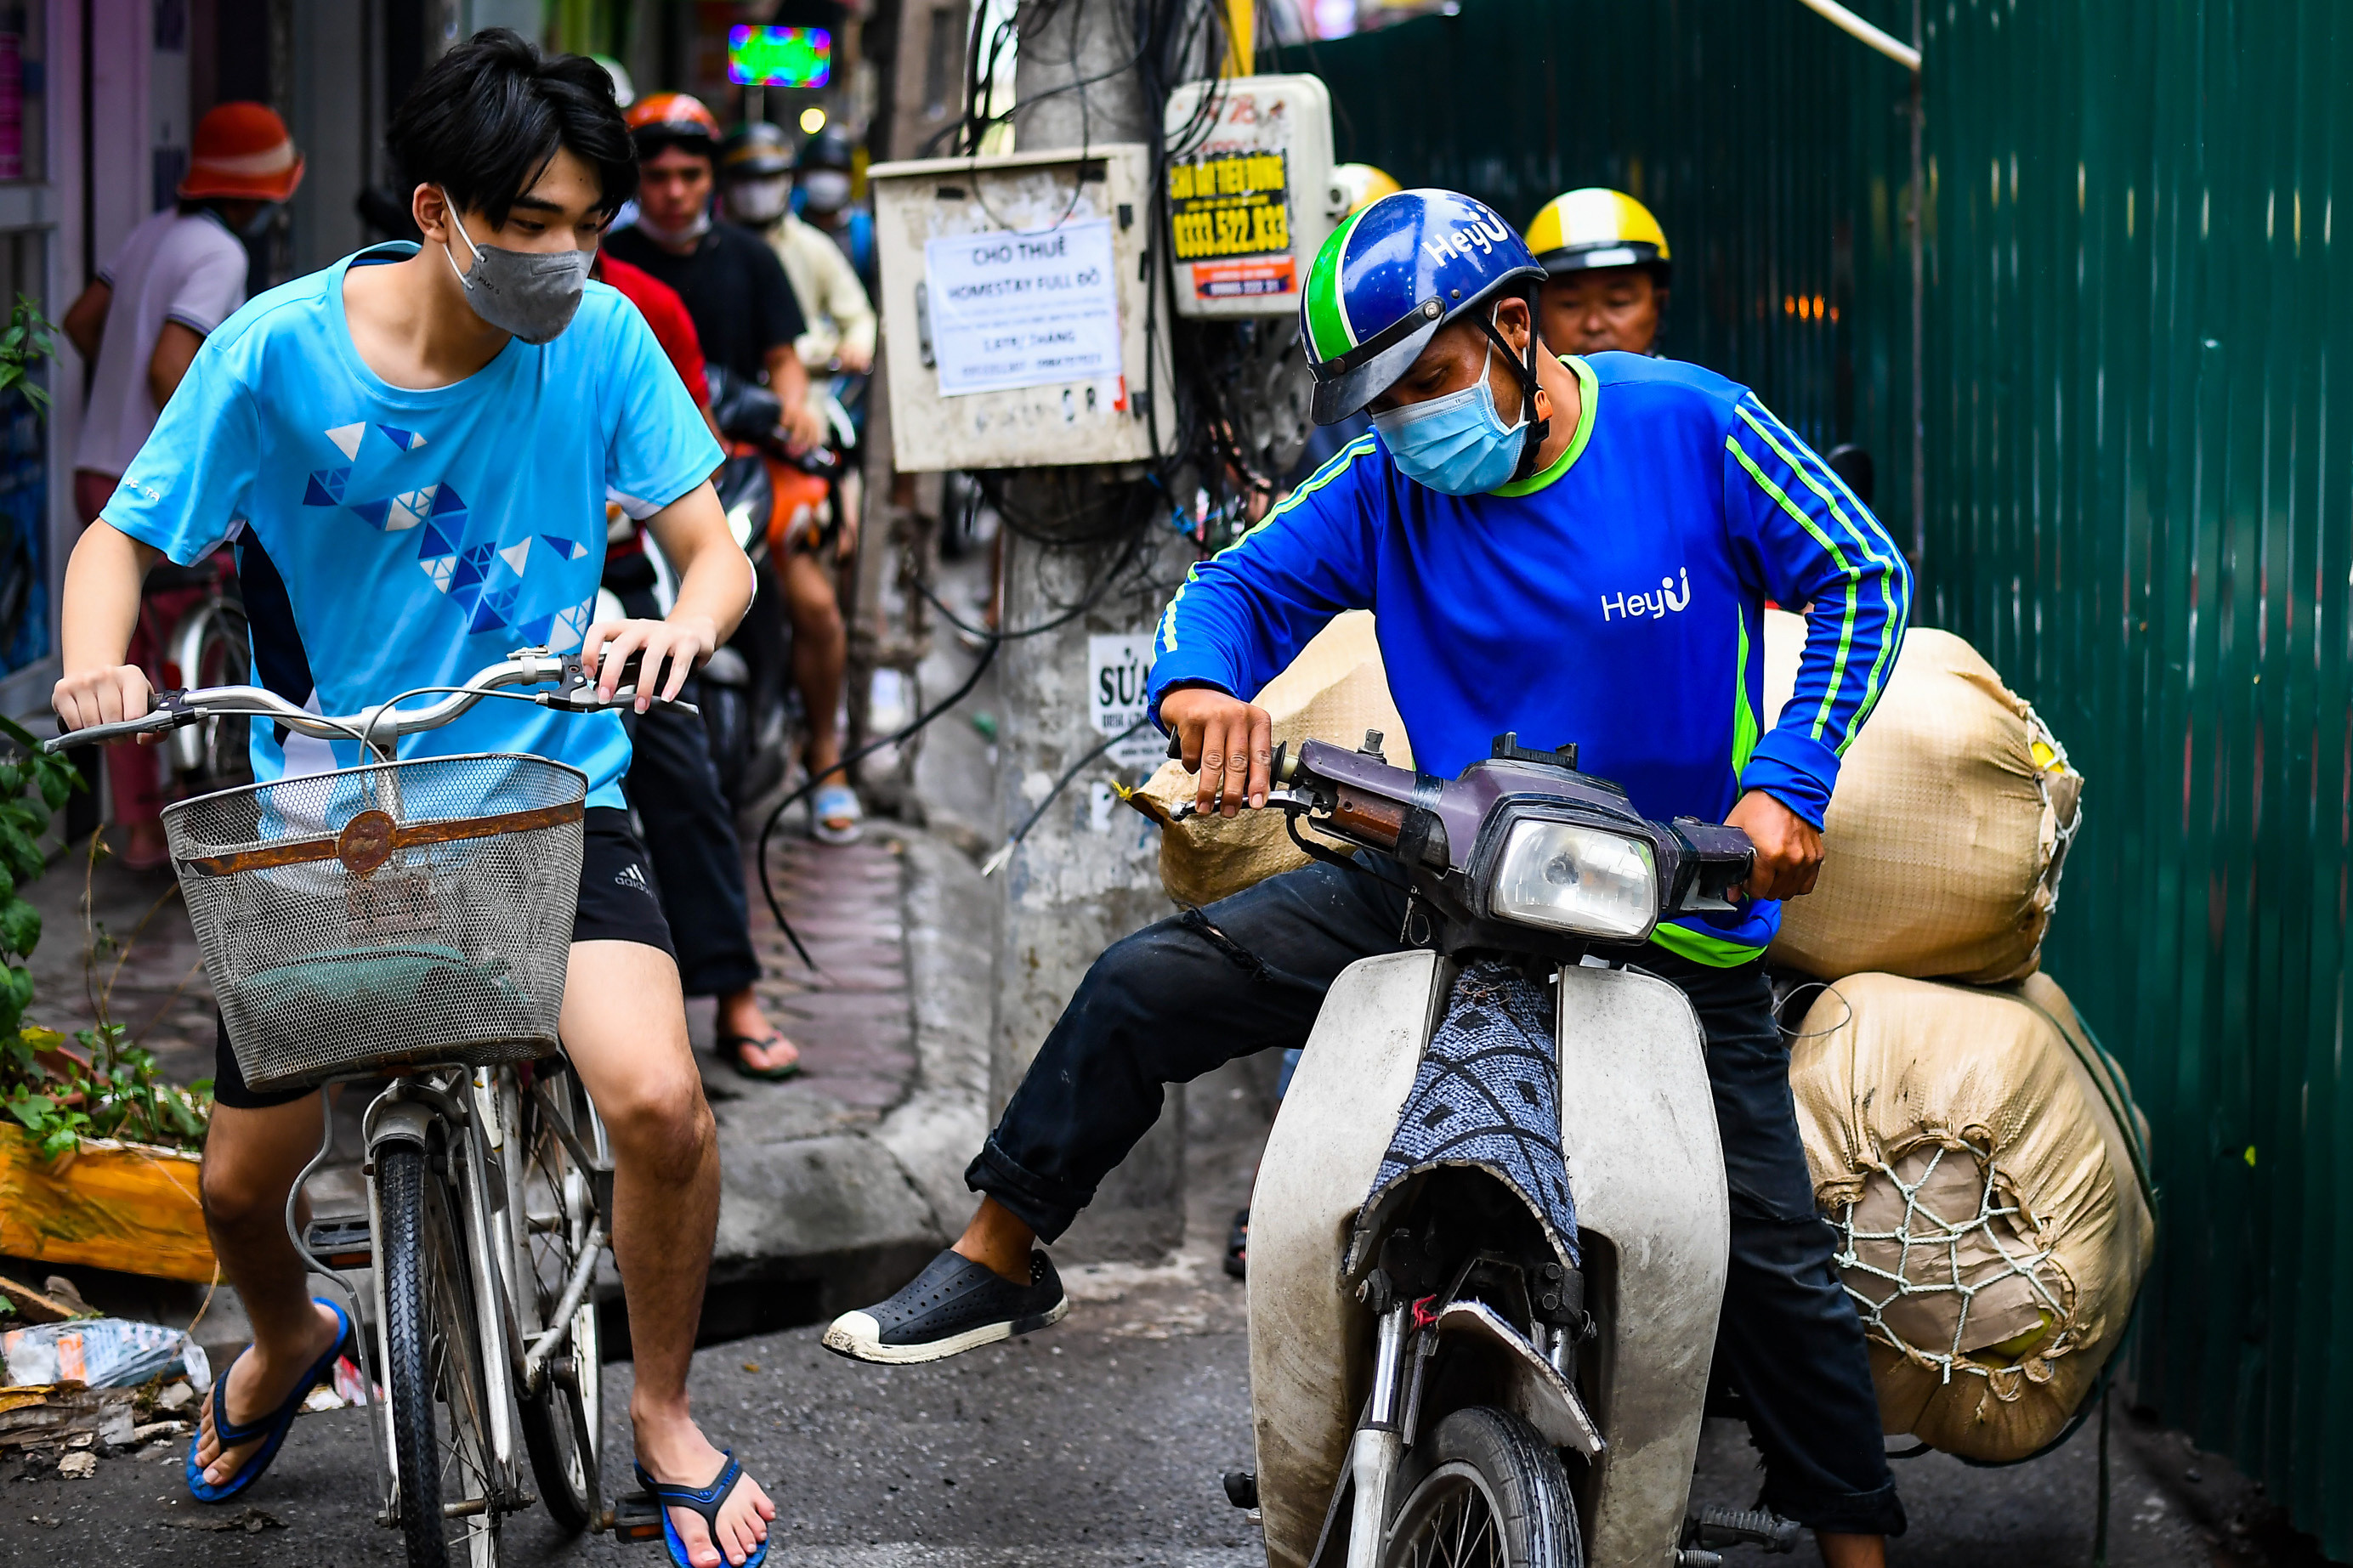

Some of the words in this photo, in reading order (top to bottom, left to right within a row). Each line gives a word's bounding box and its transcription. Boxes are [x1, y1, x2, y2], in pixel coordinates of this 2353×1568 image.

[972, 245, 1012, 266] CHO
[949, 279, 1031, 300] HOMESTAY
[1037, 275, 1072, 292] FULL
